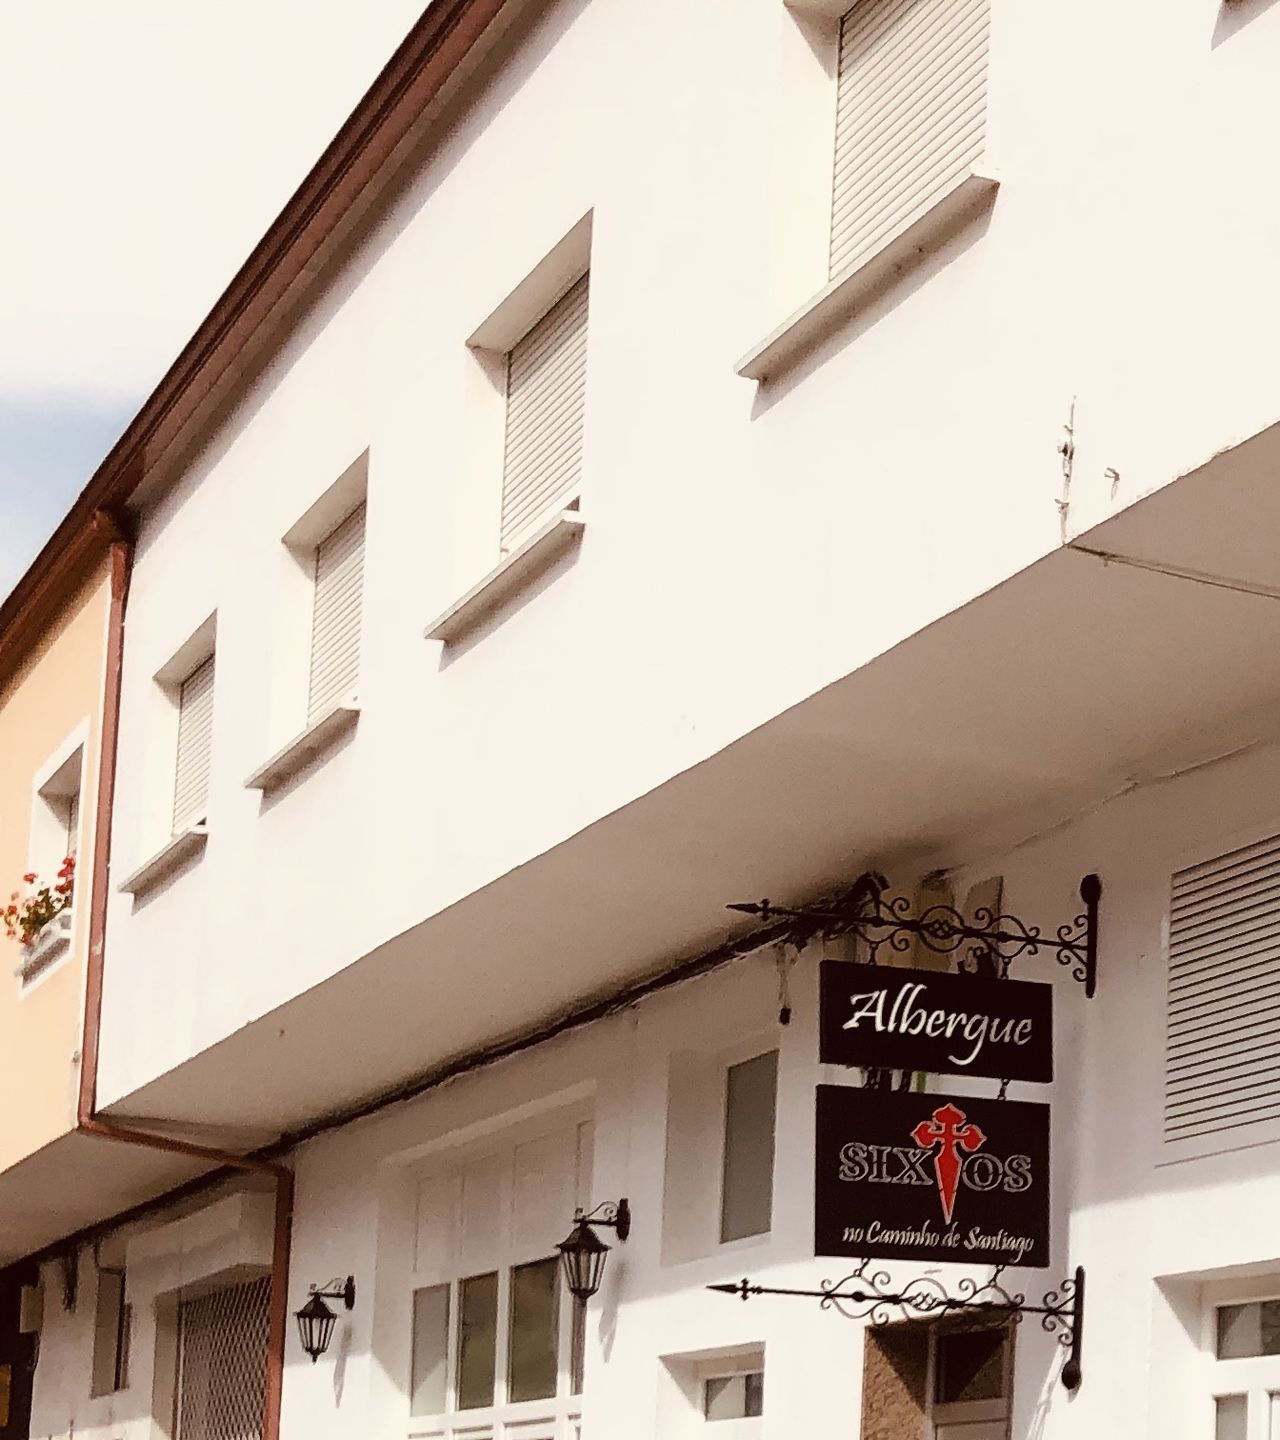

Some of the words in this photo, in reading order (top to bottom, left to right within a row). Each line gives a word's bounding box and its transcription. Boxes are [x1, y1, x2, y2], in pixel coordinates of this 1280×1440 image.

[843, 982, 1033, 1066] Albergue
[842, 1225, 864, 1243] no
[866, 1219, 939, 1249] Caminho
[942, 1221, 960, 1249] de
[964, 1225, 1035, 1264] Santiago
